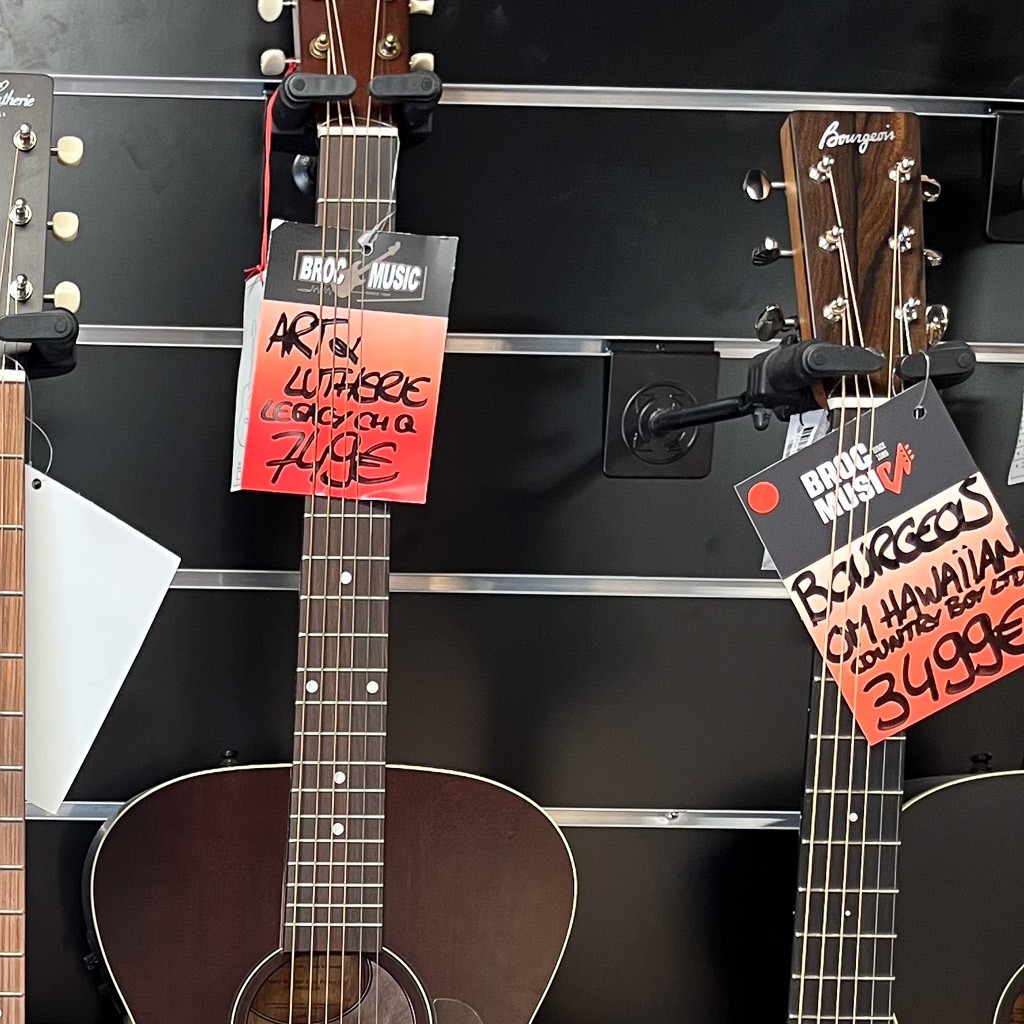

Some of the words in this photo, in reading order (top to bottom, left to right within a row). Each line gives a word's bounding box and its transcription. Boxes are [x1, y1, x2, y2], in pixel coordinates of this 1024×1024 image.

[818, 121, 896, 154] Bourgeois
[299, 255, 348, 285] BROC
[367, 261, 422, 292] MUSIC
[266, 311, 349, 360] ART
[800, 442, 873, 501] BROC
[862, 598, 1024, 731] 3499€
